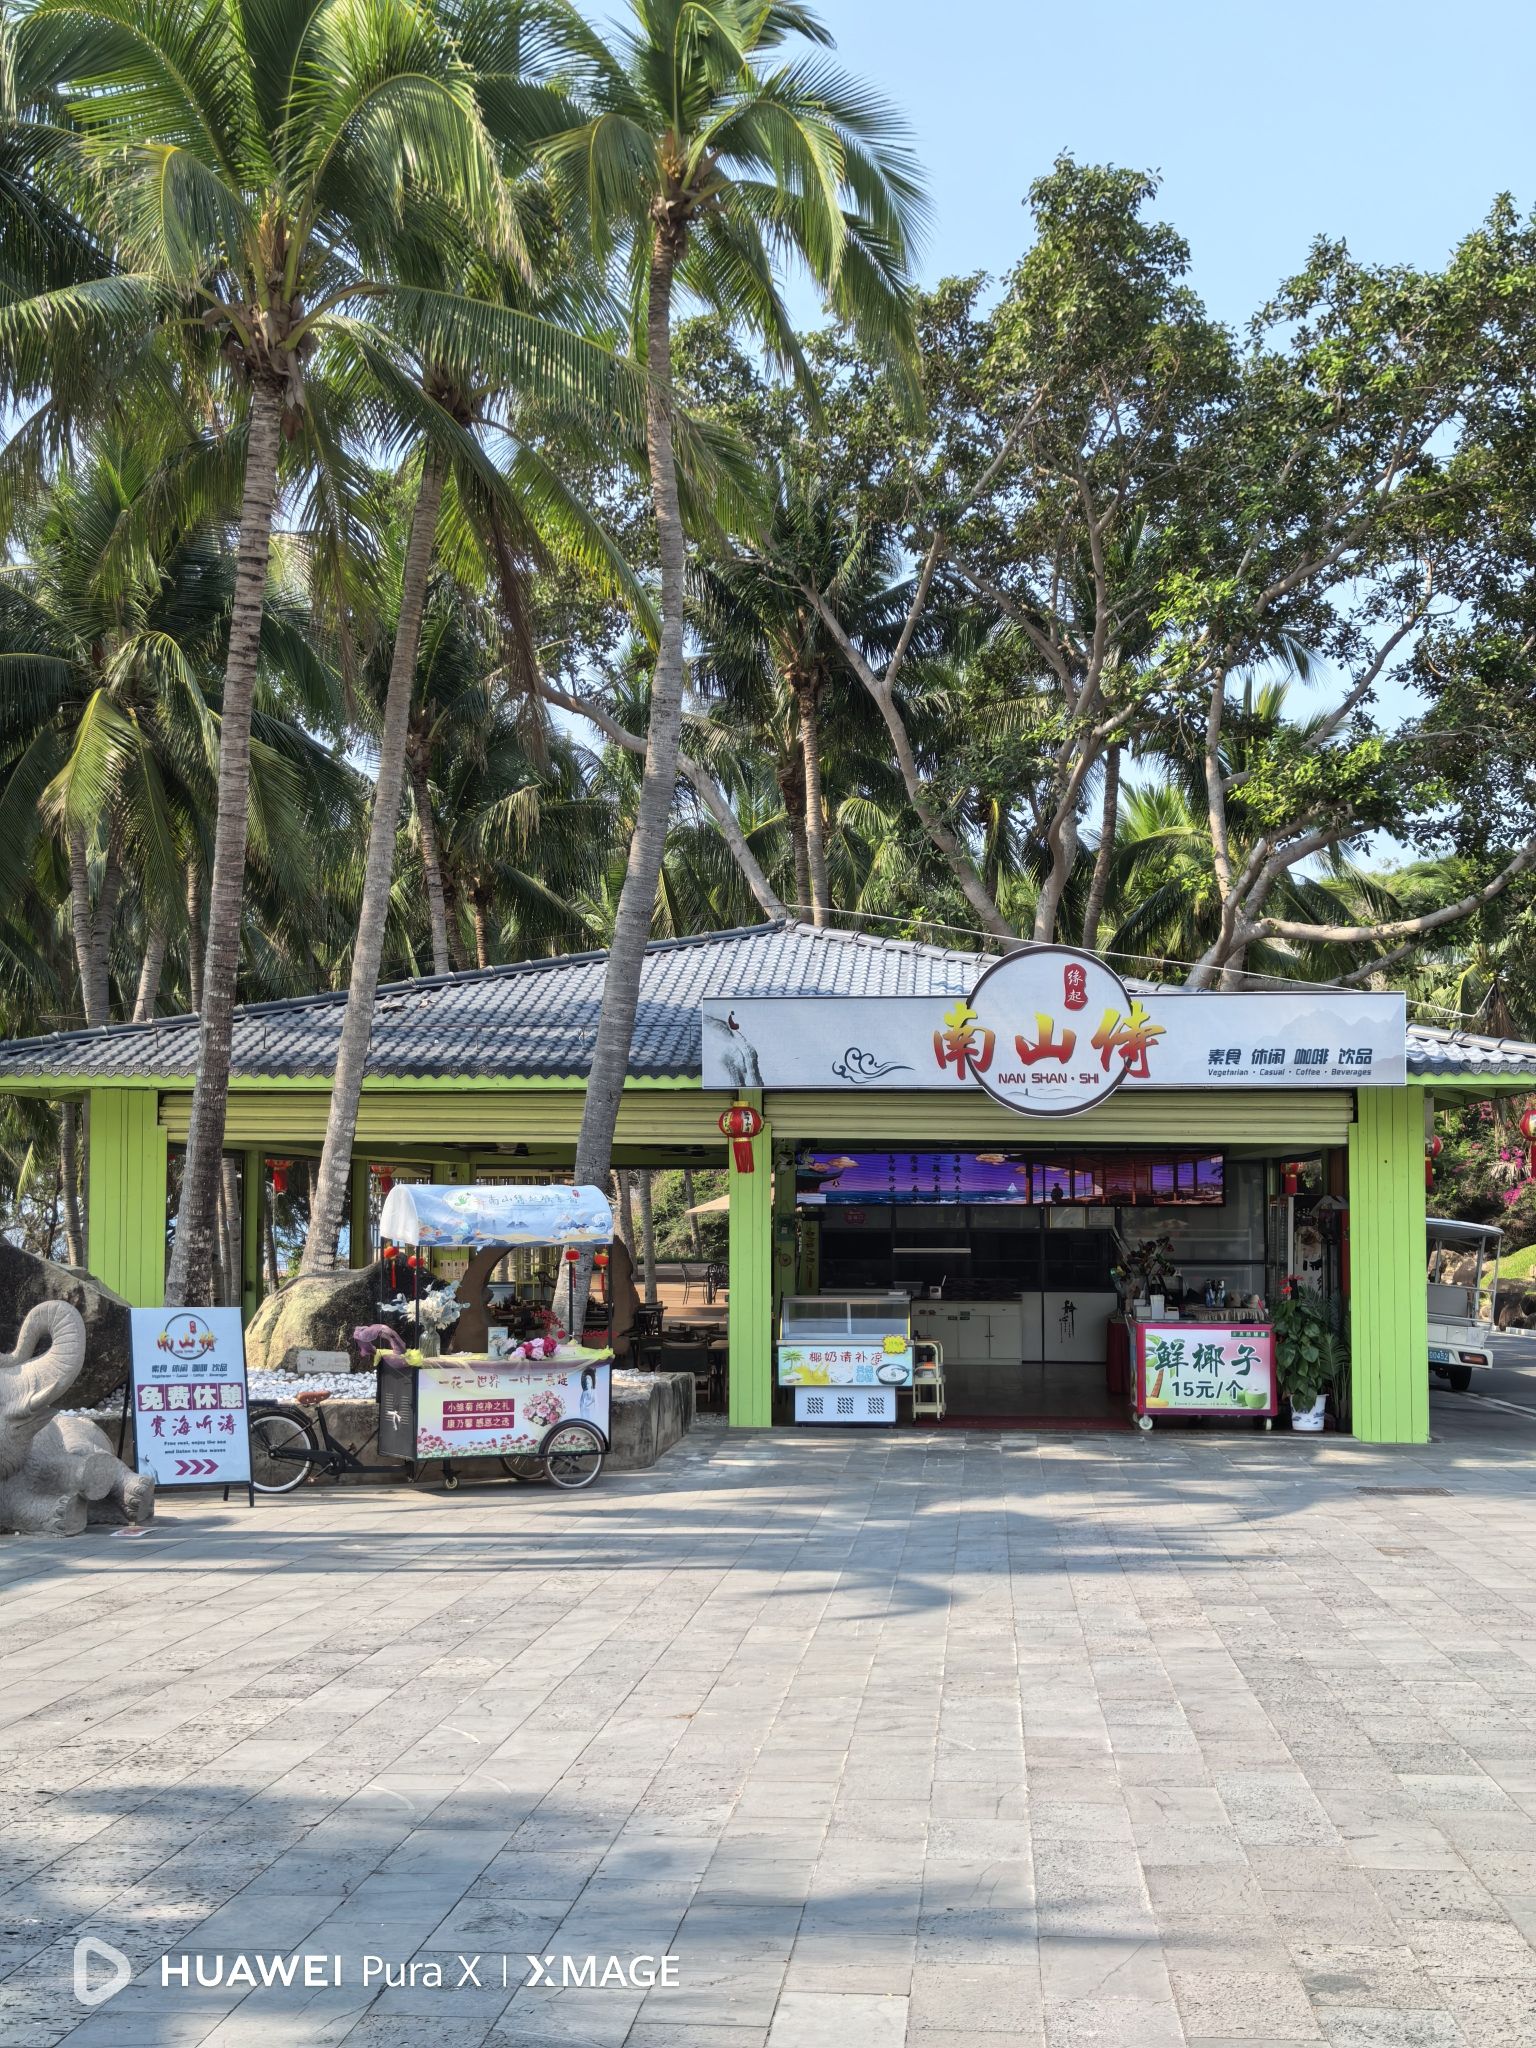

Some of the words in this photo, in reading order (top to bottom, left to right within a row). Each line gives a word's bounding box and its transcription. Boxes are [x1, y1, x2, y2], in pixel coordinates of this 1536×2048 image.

[1067, 969, 1085, 1003] 缘起
[1208, 1048, 1242, 1065] 素食
[1251, 1048, 1286, 1065] 休闲
[1293, 1048, 1330, 1065] 咖啡
[1338, 1048, 1373, 1065] 饮品
[998, 1072, 1026, 1084] NAN
[1031, 1072, 1067, 1084] SHAN
[1079, 1072, 1099, 1084] SHI
[1208, 1068, 1249, 1078] Vegetarian
[1259, 1068, 1286, 1077] Casual
[1295, 1068, 1321, 1077] Coffee
[1331, 1068, 1372, 1078] Beverages
[1154, 1338, 1262, 1378] 鲜椰子
[438, 1374, 501, 1389] 一花一世界
[508, 1372, 569, 1387] 一叶一菩提
[1171, 1379, 1244, 1400] 15元/个
[139, 1384, 243, 1411] 免费休憩
[447, 1402, 474, 1413] 小雏菊
[475, 1401, 511, 1412] 纯净之礼
[150, 1413, 237, 1438] 赏海听涛
